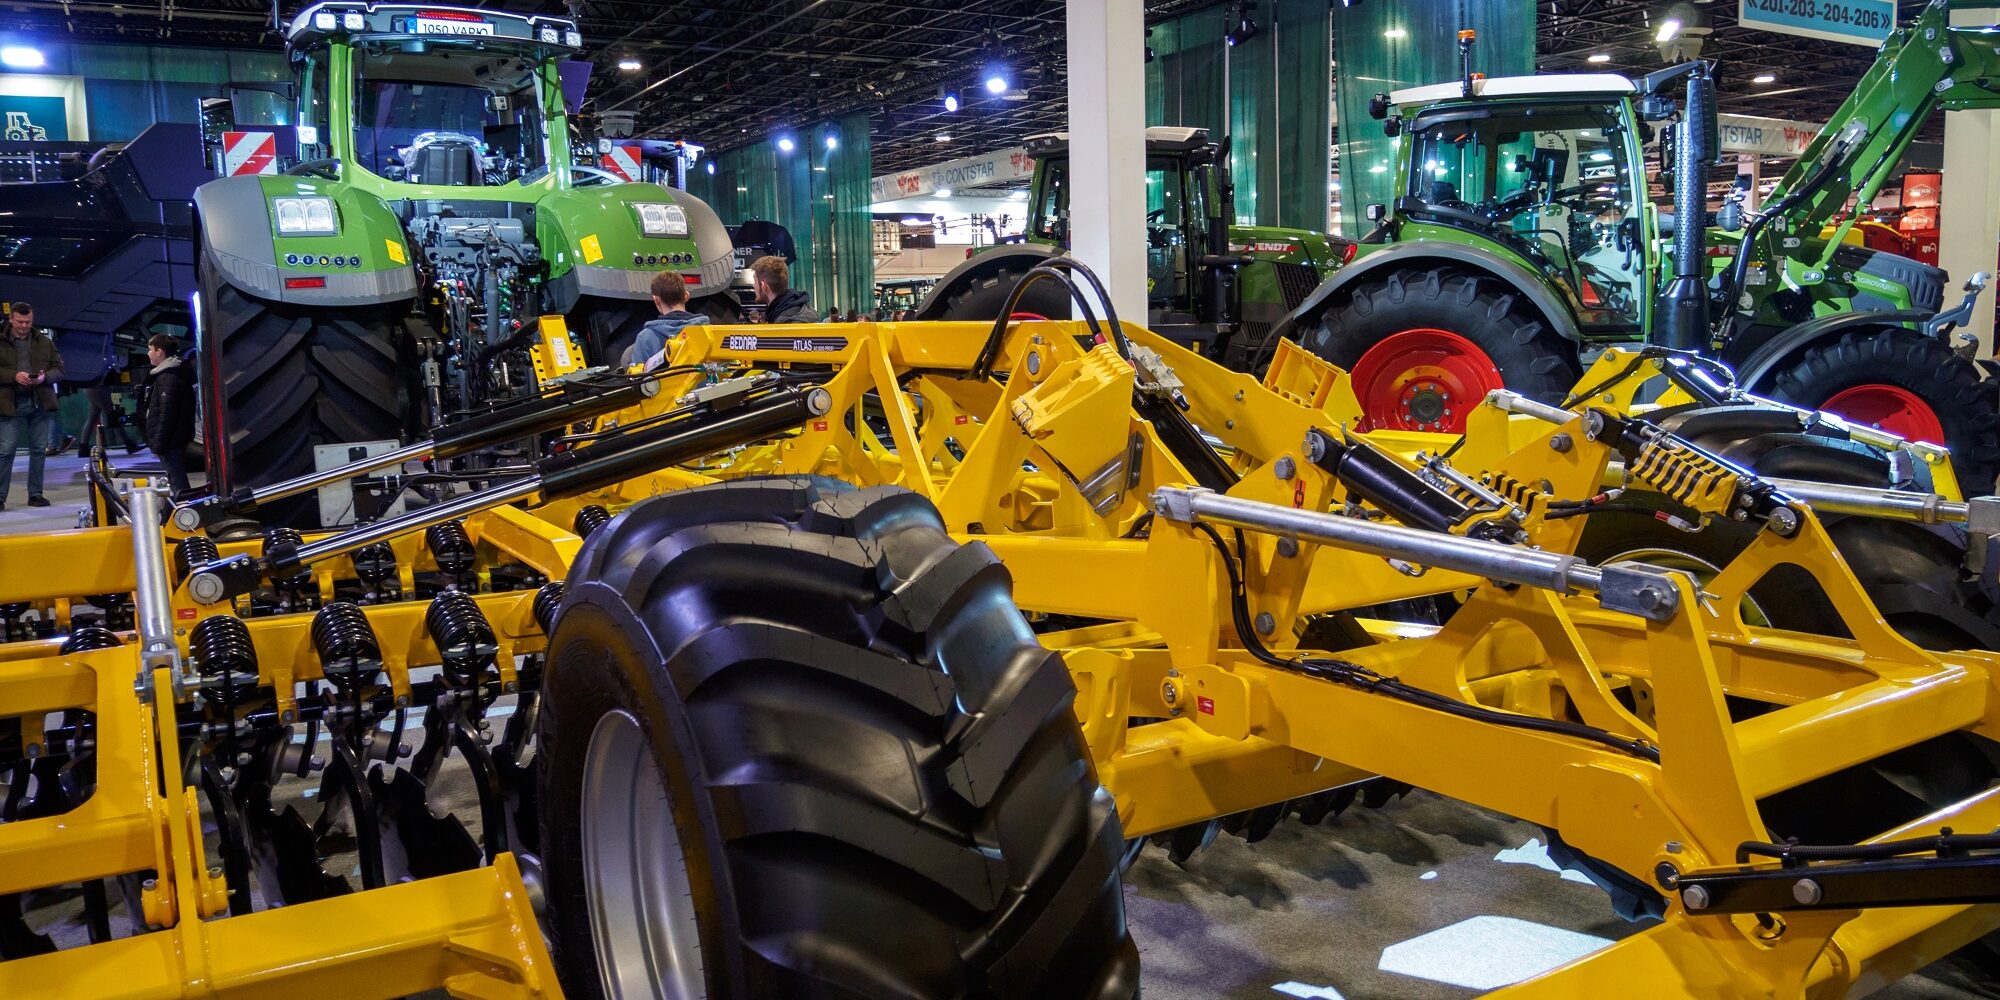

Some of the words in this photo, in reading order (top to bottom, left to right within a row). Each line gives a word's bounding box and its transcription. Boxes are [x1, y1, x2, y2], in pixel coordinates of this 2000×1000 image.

[946, 161, 994, 184] CONTSTAR
[729, 335, 757, 350] BEDNAR
[793, 340, 812, 351] ATLAS
